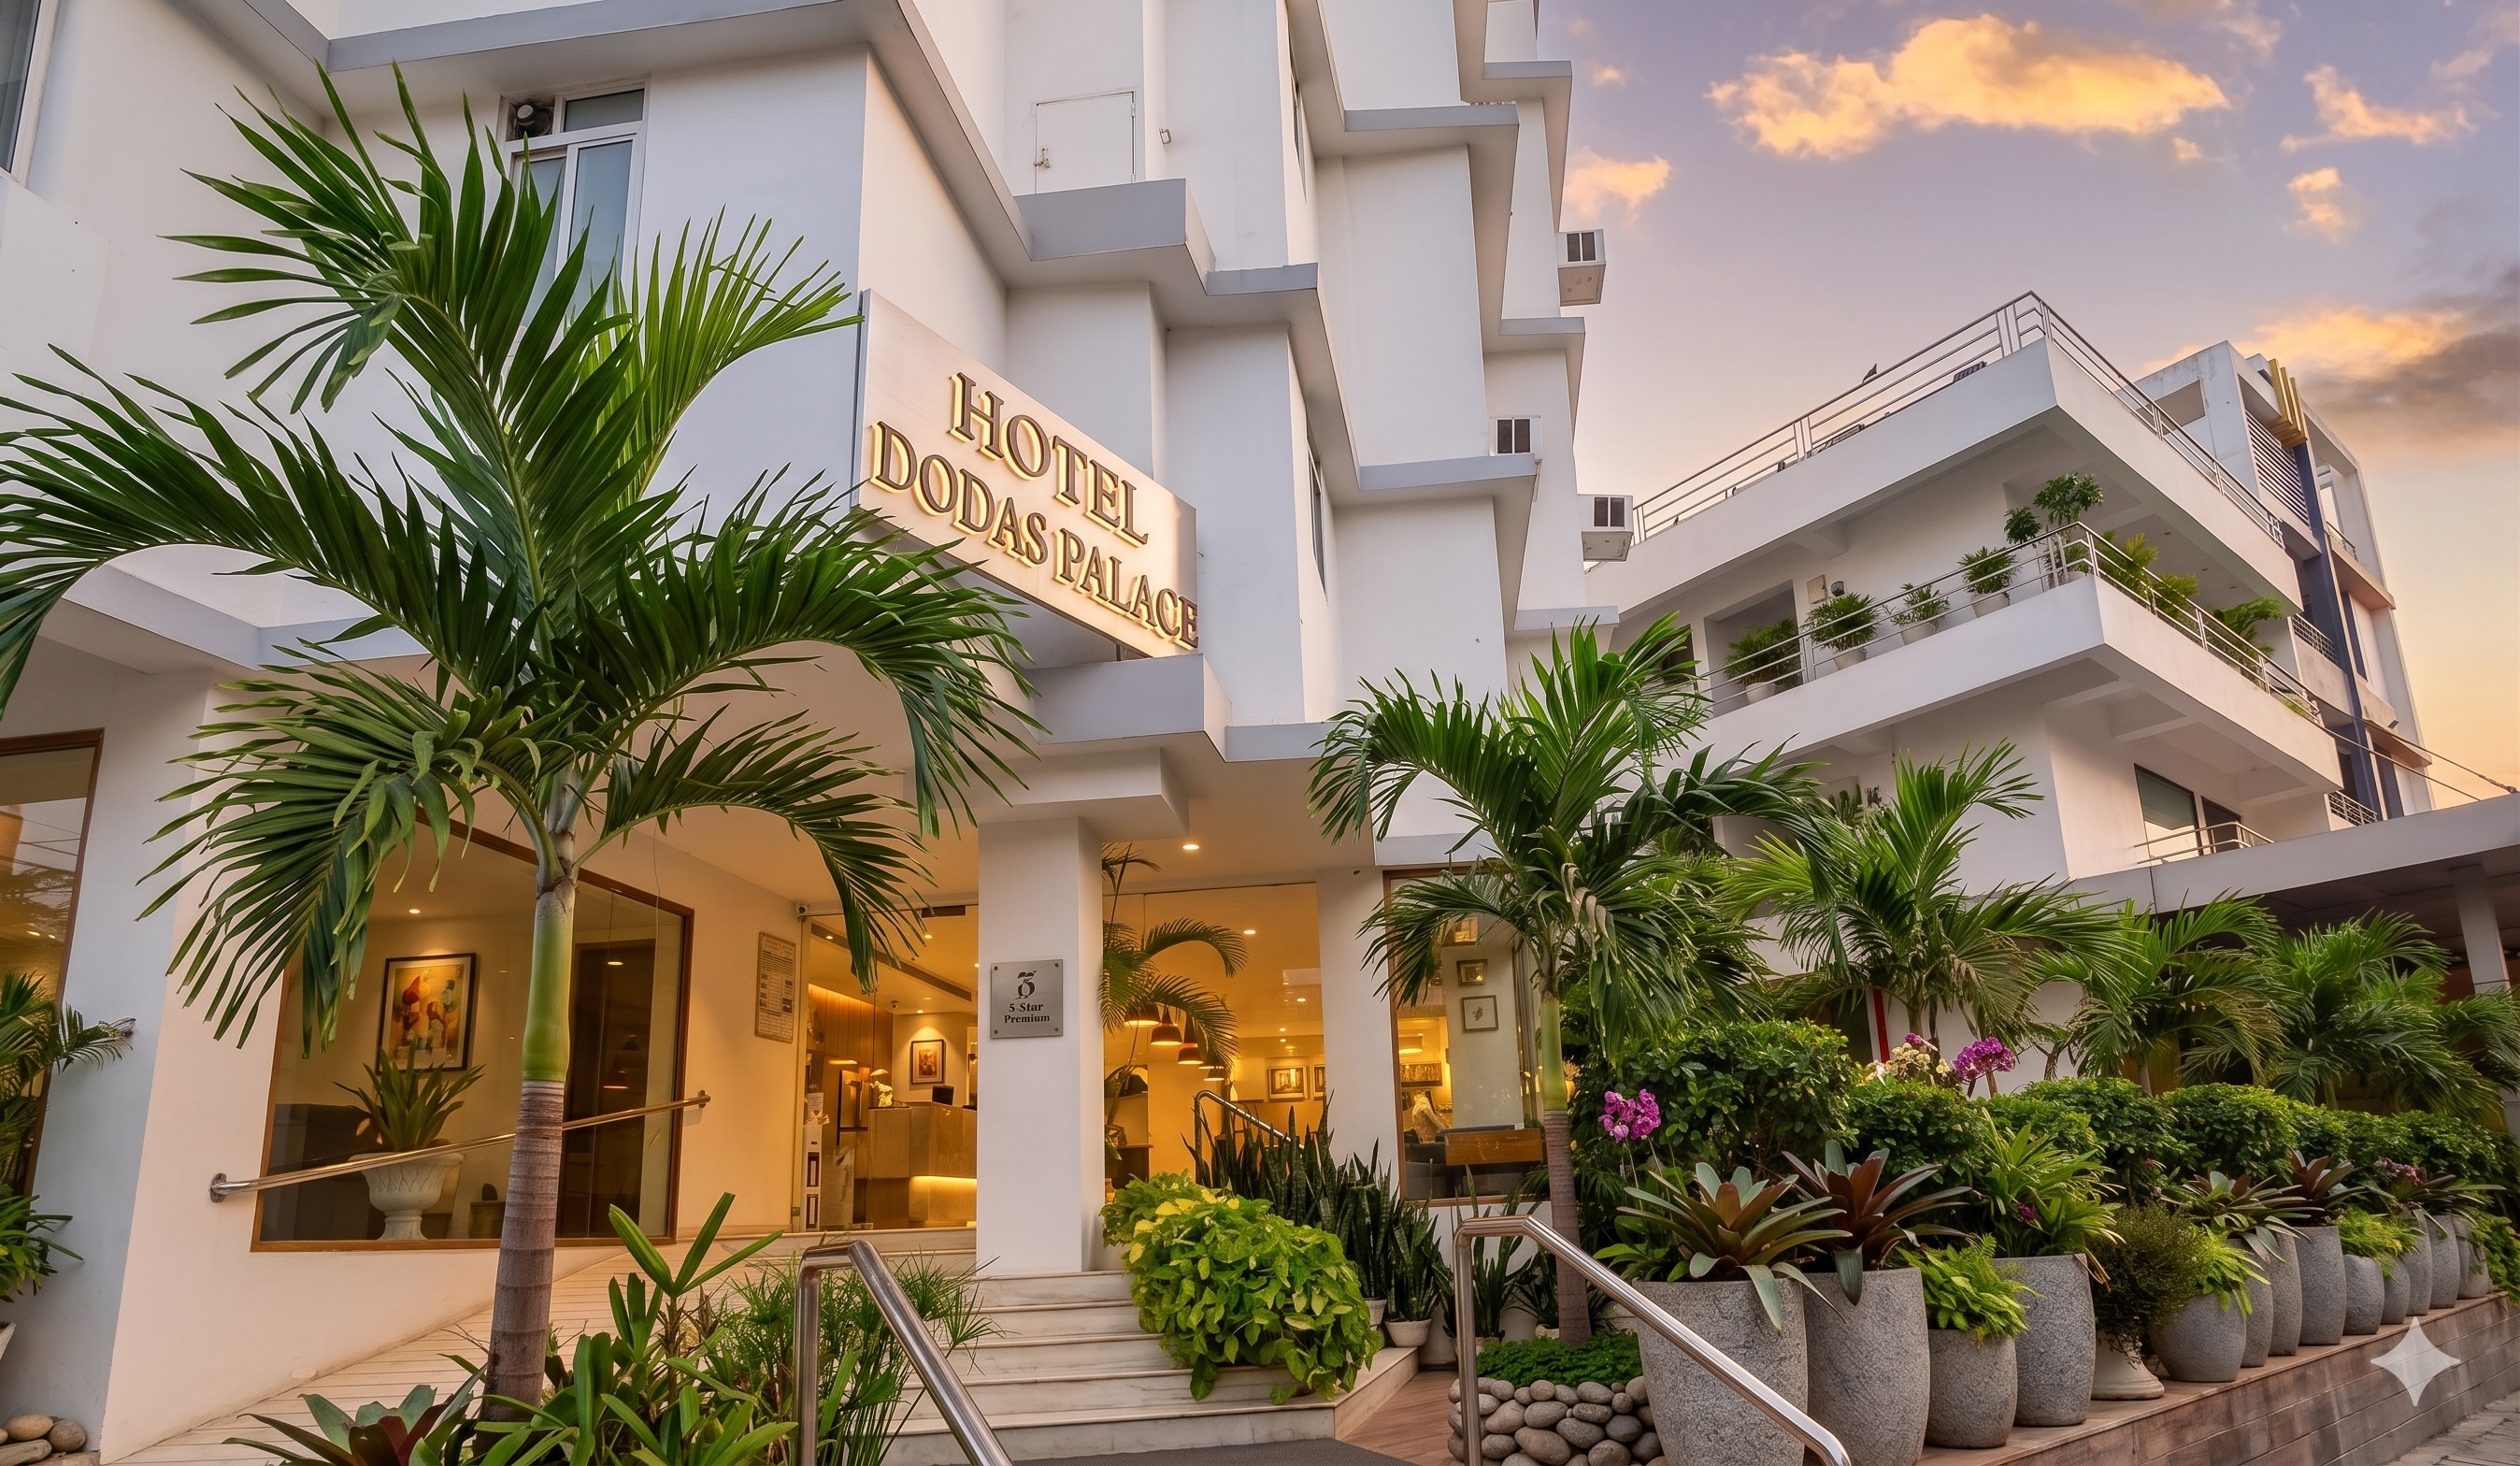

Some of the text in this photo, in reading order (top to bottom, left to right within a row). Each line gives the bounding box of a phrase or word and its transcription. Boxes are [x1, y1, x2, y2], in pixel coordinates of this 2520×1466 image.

[869, 421, 1199, 650] DODAS PALACE
[948, 371, 1148, 547] HOTEL
[1004, 1013, 1051, 1024] Premium
